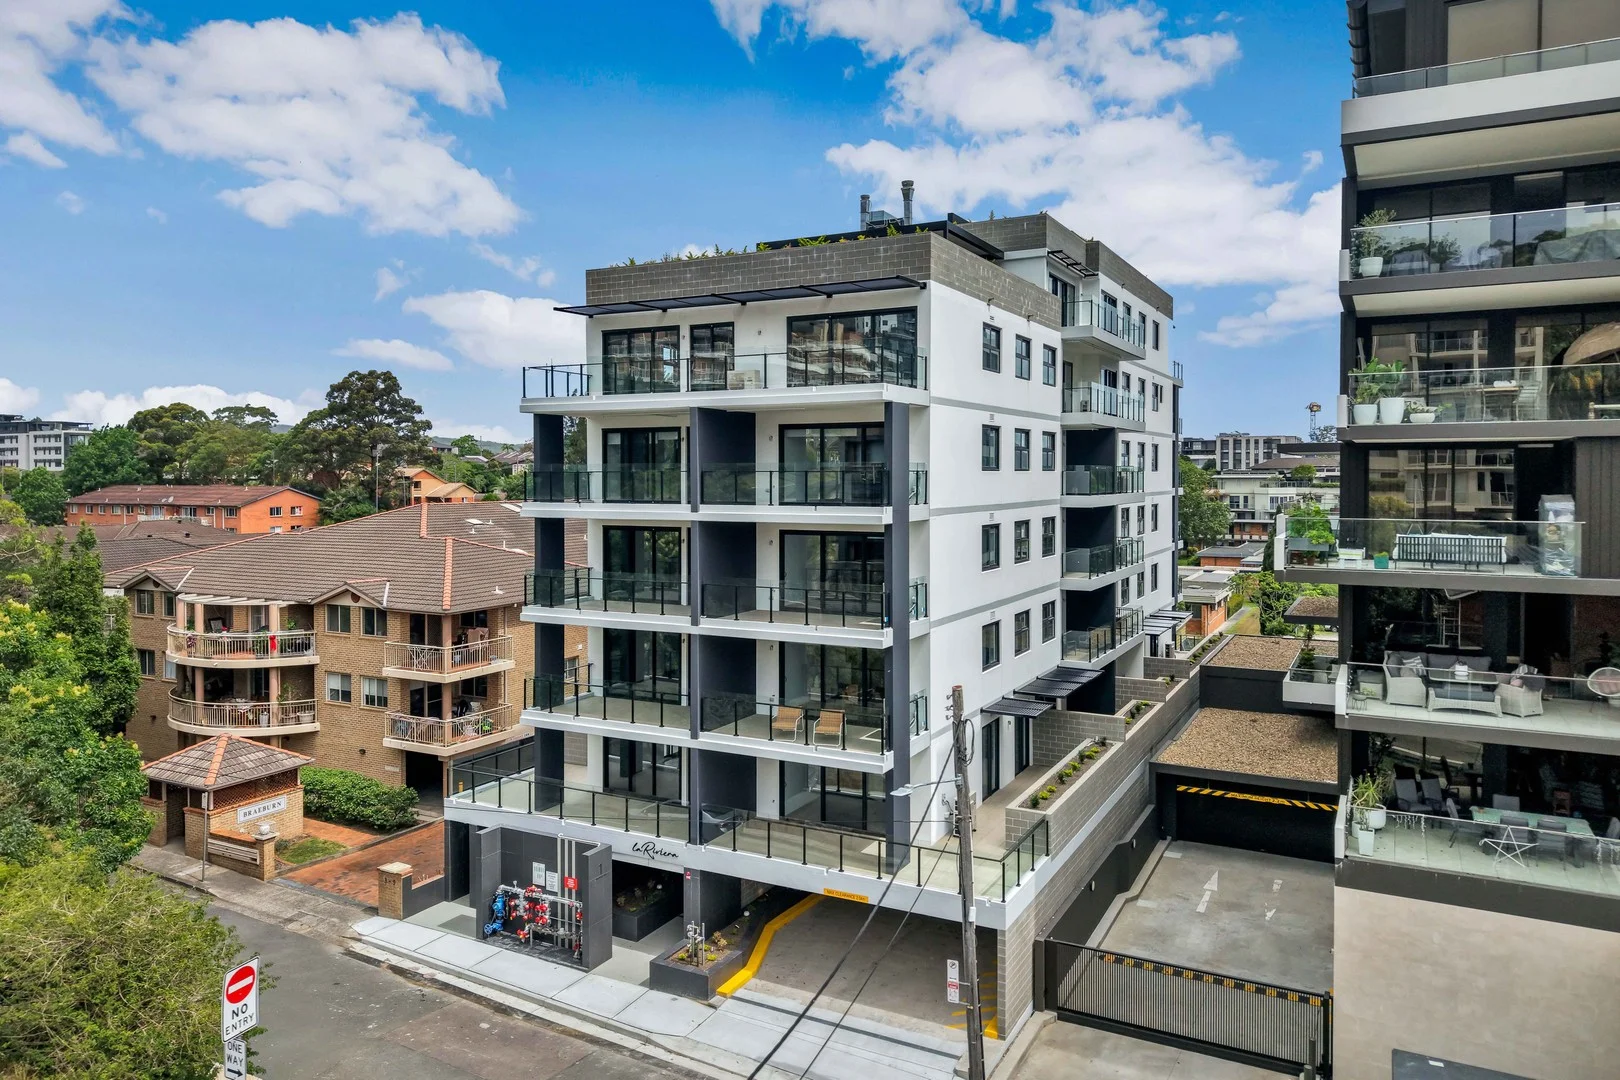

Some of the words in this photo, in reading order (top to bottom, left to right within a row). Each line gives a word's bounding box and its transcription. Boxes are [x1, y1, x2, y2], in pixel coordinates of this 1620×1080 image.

[243, 801, 282, 818] BRAEBURN
[231, 1003, 249, 1020] NO
[225, 1012, 255, 1036] ENTRY
[227, 1041, 243, 1054] ONE
[226, 1053, 244, 1067] WAY
